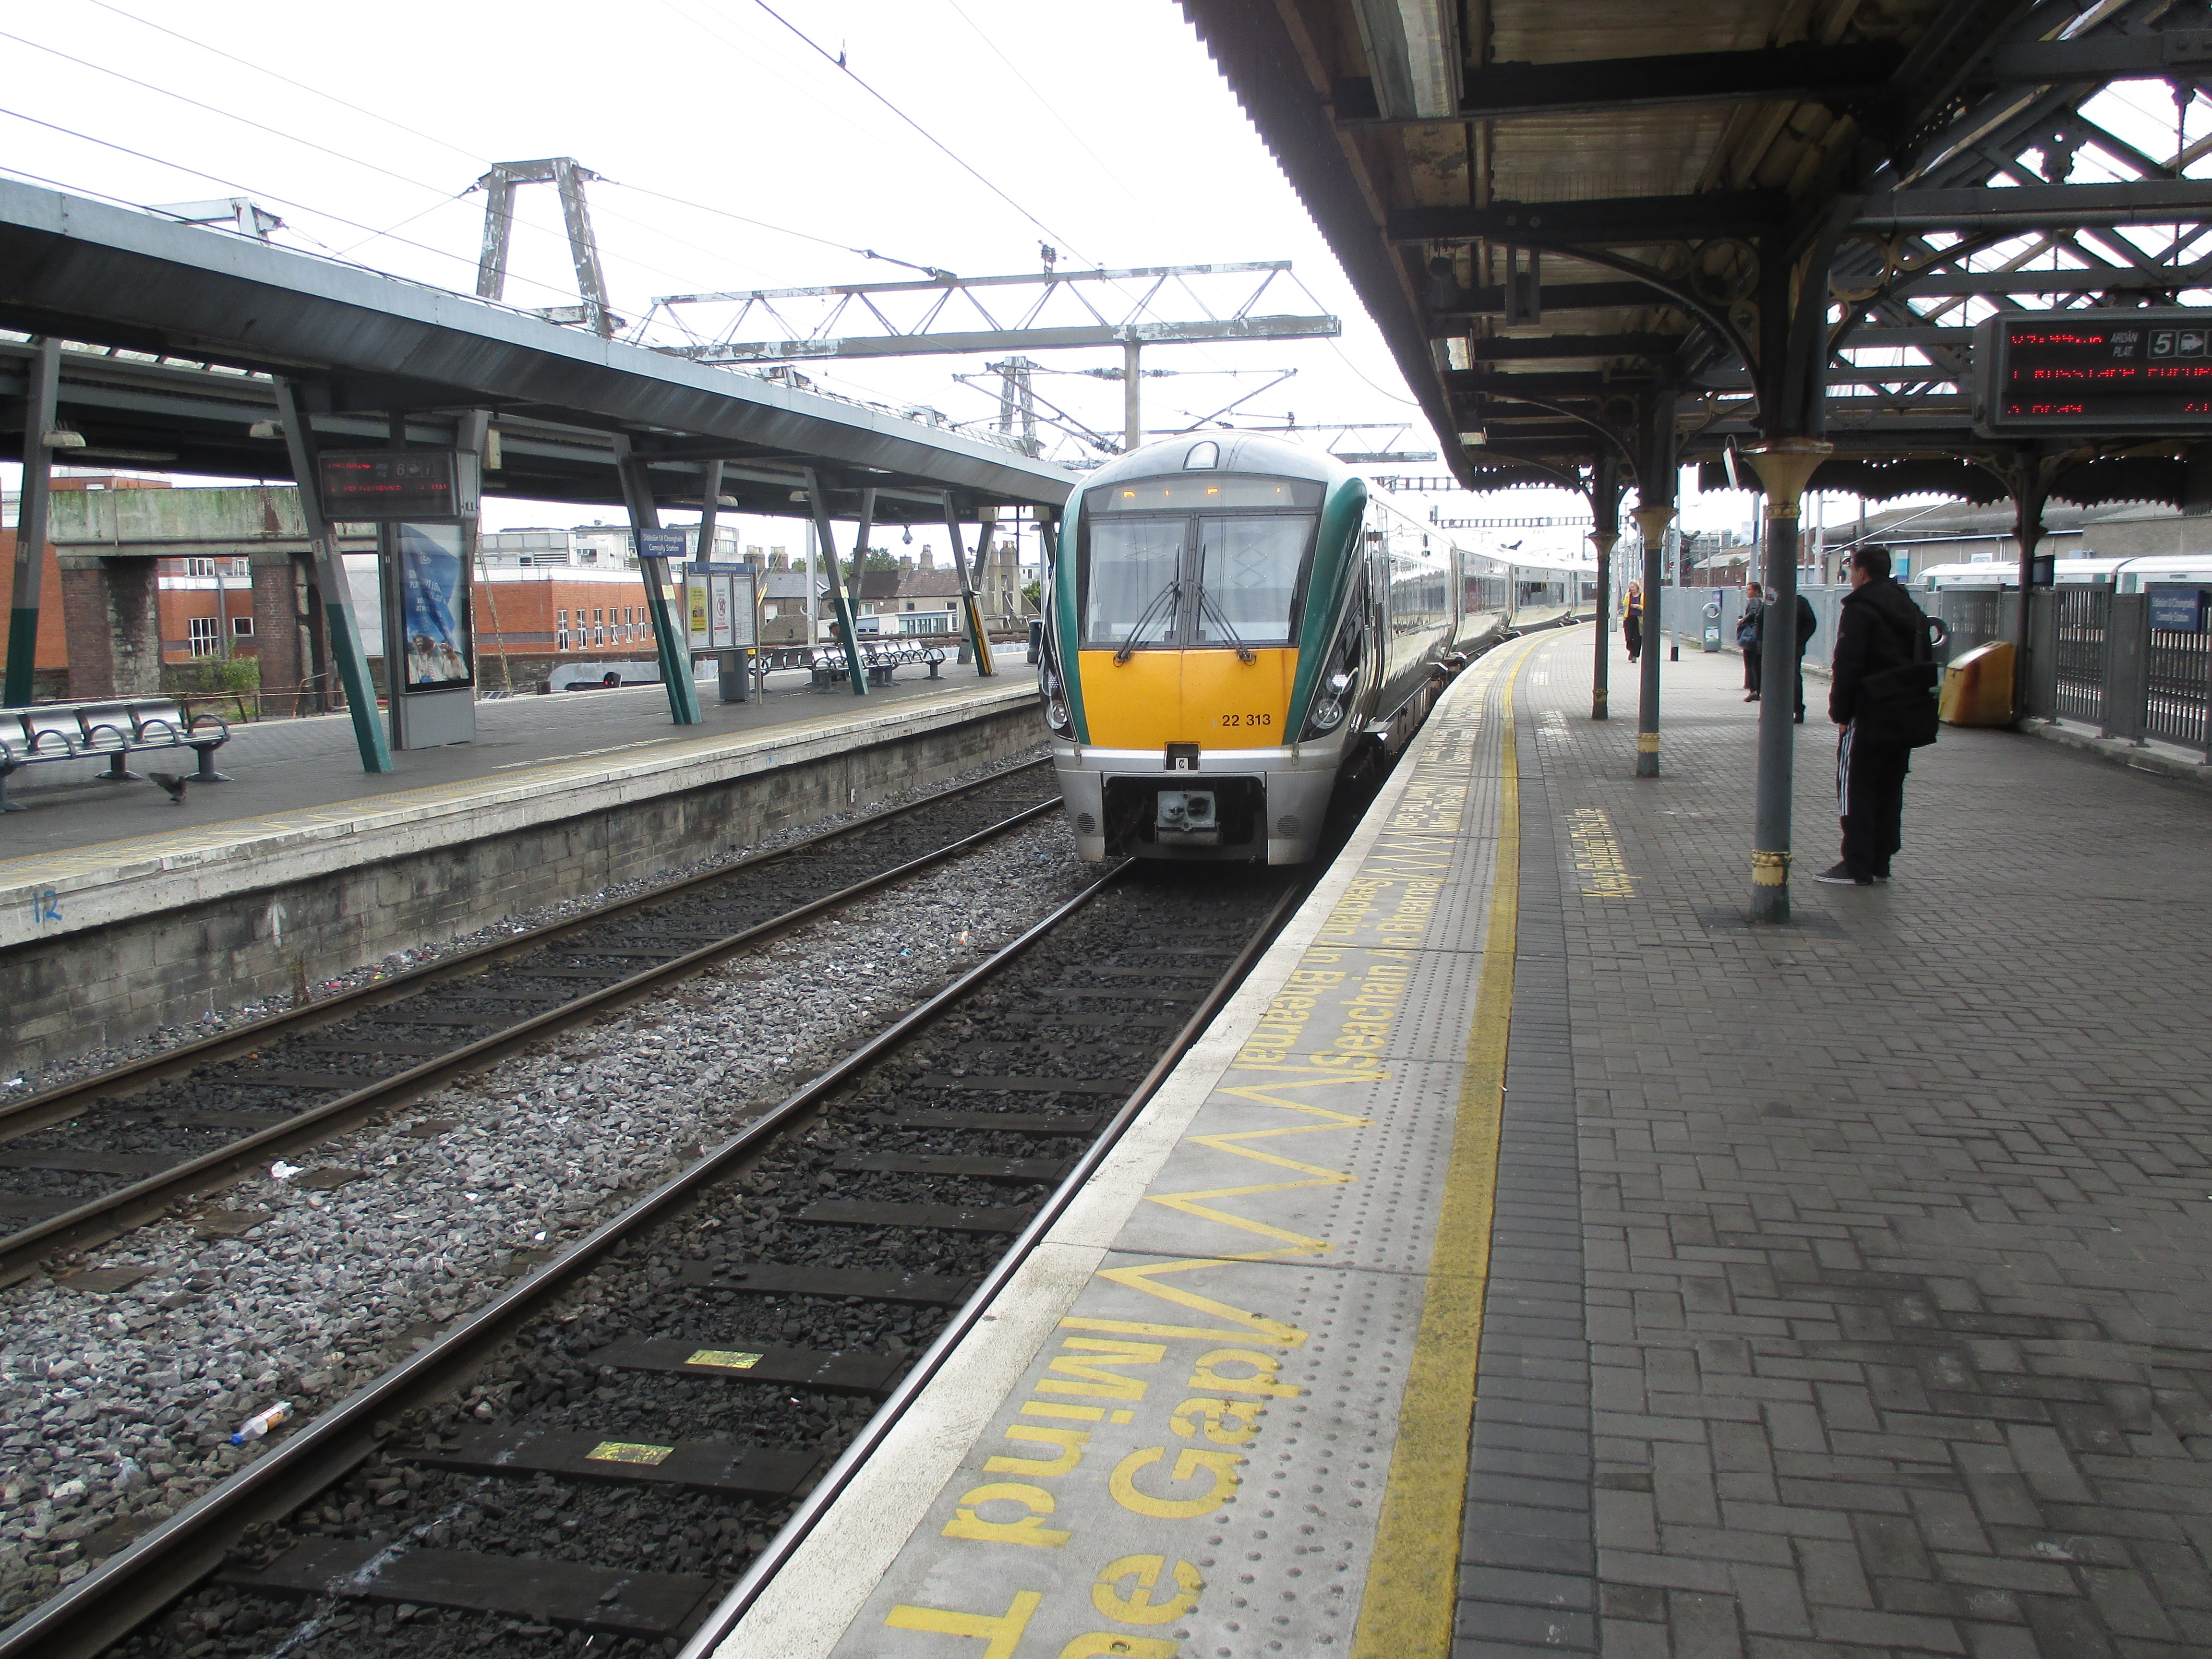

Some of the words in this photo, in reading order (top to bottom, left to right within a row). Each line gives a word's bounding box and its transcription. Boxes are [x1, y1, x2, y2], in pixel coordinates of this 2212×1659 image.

[2153, 333, 2173, 354] 5
[1222, 714, 1240, 726] 22
[1246, 714, 1271, 726] 313
[1398, 800, 1434, 812] The
[1432, 799, 1466, 810] The
[1385, 813, 1430, 827] Gap
[1428, 811, 1463, 828] Mind
[1581, 872, 1643, 898] Keep
[33, 889, 63, 924] 12
[1319, 879, 1394, 936] Seachain
[1375, 881, 1441, 933] Bhearna
[1300, 939, 1359, 964] An
[1364, 937, 1421, 961] An
[1234, 970, 1347, 1063] Bhearna
[1309, 965, 1411, 1069] Seachain
[940, 1336, 1167, 1548] Mind
[1109, 1348, 1302, 1519] Gap
